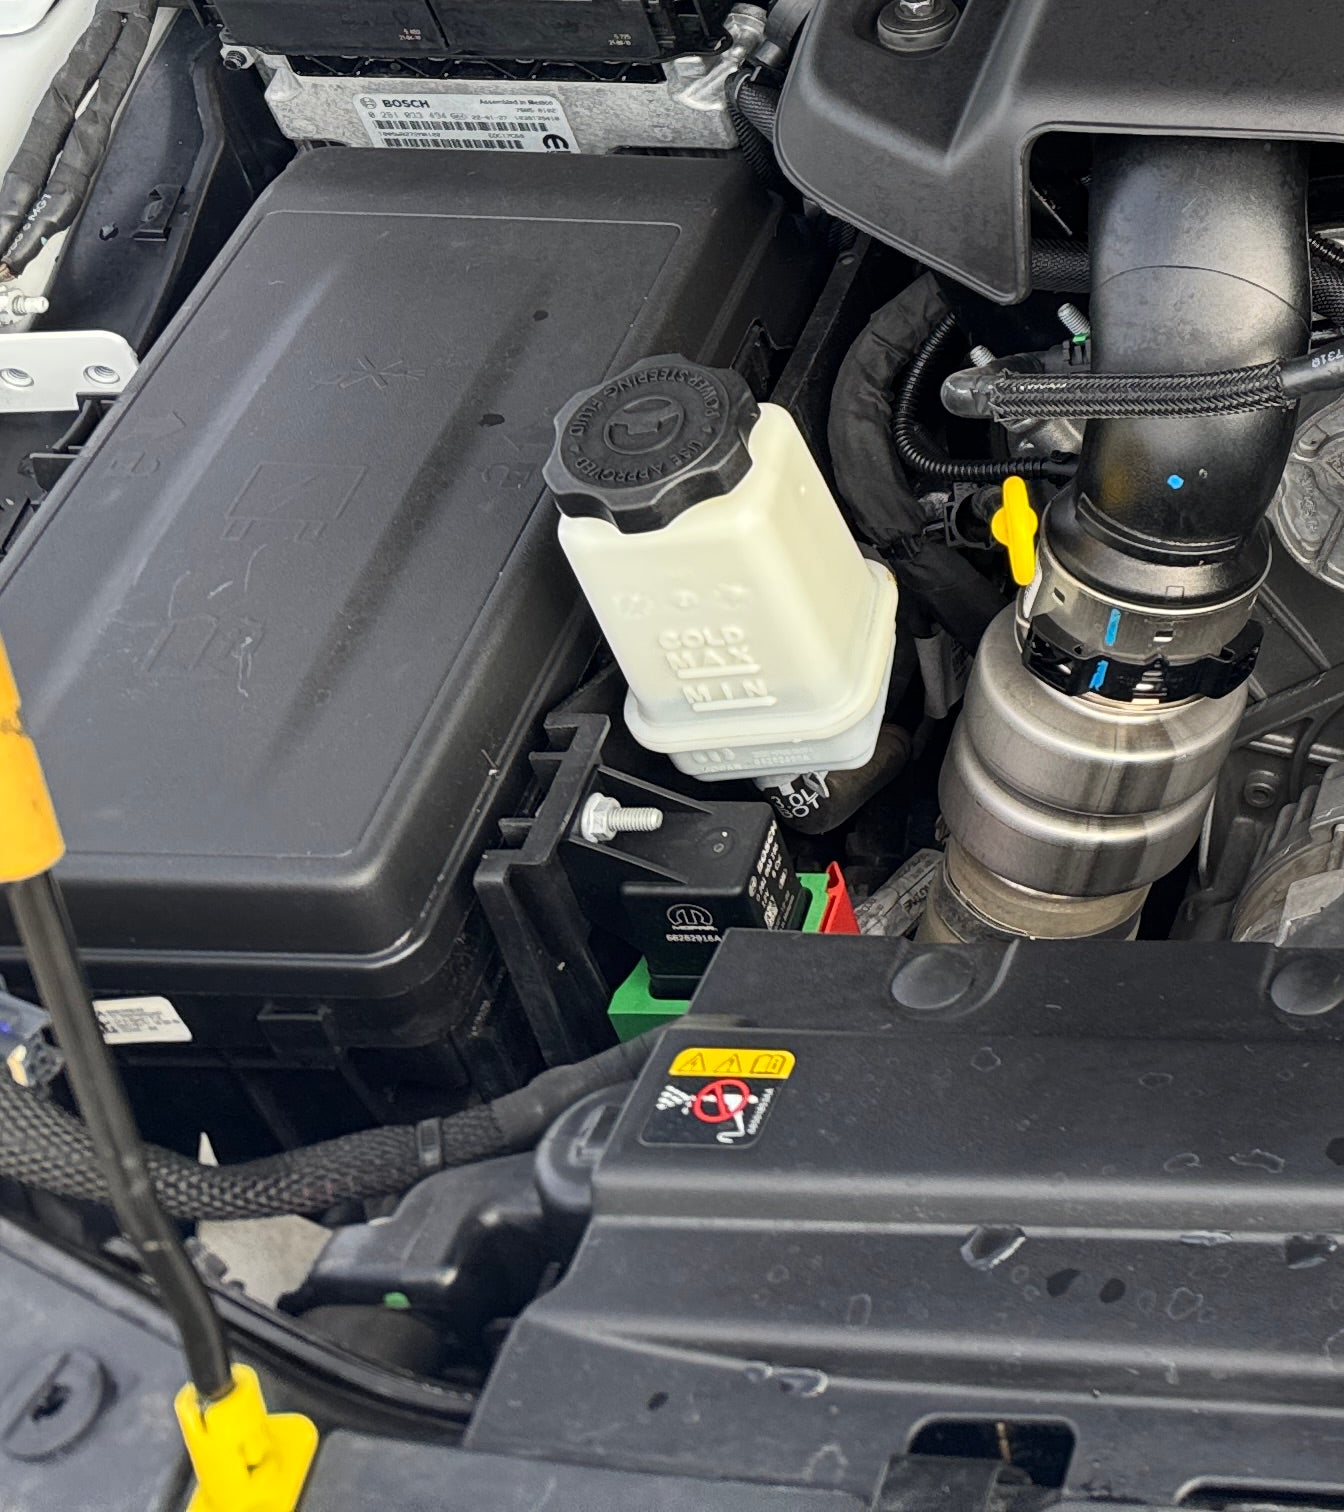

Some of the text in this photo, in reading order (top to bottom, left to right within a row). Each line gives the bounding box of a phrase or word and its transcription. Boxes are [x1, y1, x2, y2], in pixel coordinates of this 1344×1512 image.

[382, 99, 430, 108] BOSCH
[569, 367, 721, 436] POWER STEERING FLUID
[576, 439, 704, 483] USE APPROVED
[658, 624, 744, 650] COLD
[665, 645, 754, 671] MAX
[682, 678, 768, 704] MIN
[757, 819, 778, 874] BOSCH
